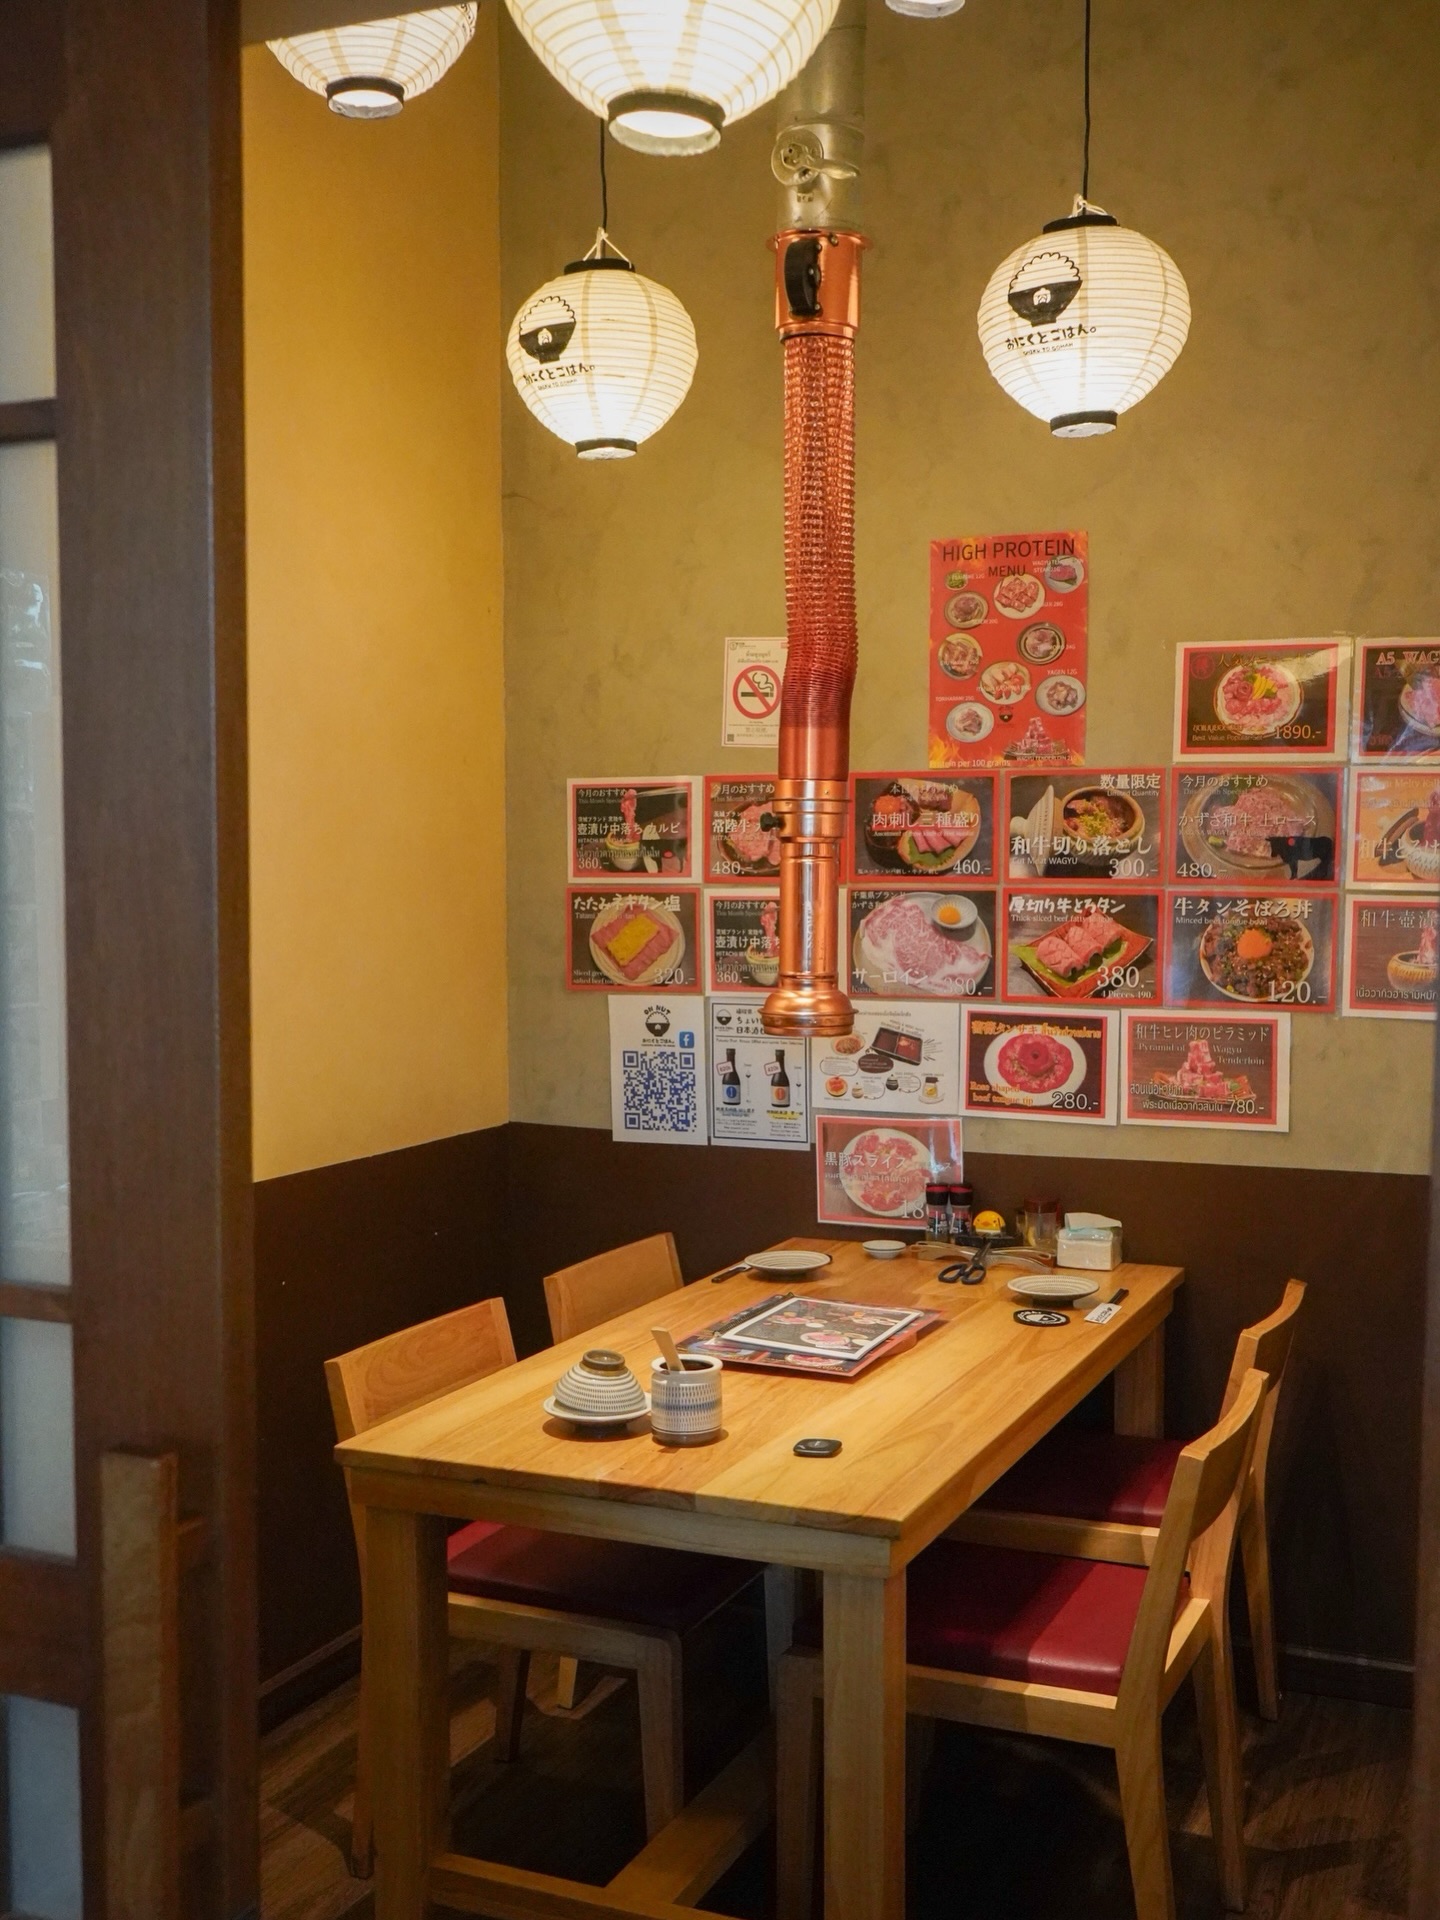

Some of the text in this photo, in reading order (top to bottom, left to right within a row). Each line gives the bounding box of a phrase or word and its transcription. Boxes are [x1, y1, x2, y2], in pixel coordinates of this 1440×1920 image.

[943, 538, 1075, 562] HIGH PROTEIN
[987, 564, 1026, 577] MENU
[1375, 650, 1440, 666] A5 WAG
[1274, 724, 1322, 740] 1890.-
[972, 759, 987, 767] 100
[712, 783, 775, 795] 今月のおすすめ
[1099, 773, 1161, 790] 数量限定
[1181, 774, 1268, 787] 今月のおすすめ
[872, 811, 980, 829] 肉刺し三種盛り
[1010, 836, 1152, 857] 和牛切り落とし
[577, 857, 610, 870] 360.-
[711, 860, 755, 875] 480.-
[952, 858, 991, 875] 460.-
[1048, 857, 1079, 867] WAGYU
[1108, 857, 1158, 877] 300.-
[1176, 862, 1228, 879] 480.-
[1009, 896, 1127, 915] 厚切り牛とろタン
[1174, 897, 1313, 920] 牛タンそぼろ丼
[1175, 916, 1203, 925] Minced
[653, 967, 696, 985] 320.-
[716, 971, 750, 983] 360.-
[852, 967, 928, 986] サーロイン
[1096, 965, 1155, 989] 380.-
[1266, 980, 1328, 1004] 120.-
[656, 1005, 671, 1015] NUT
[1135, 1023, 1270, 1043] 和牛ヒレ肉のピラミッド
[1212, 1044, 1243, 1055] Wagyu
[1051, 1091, 1100, 1111] 280.-
[1226, 1099, 1266, 1115] 780.-
